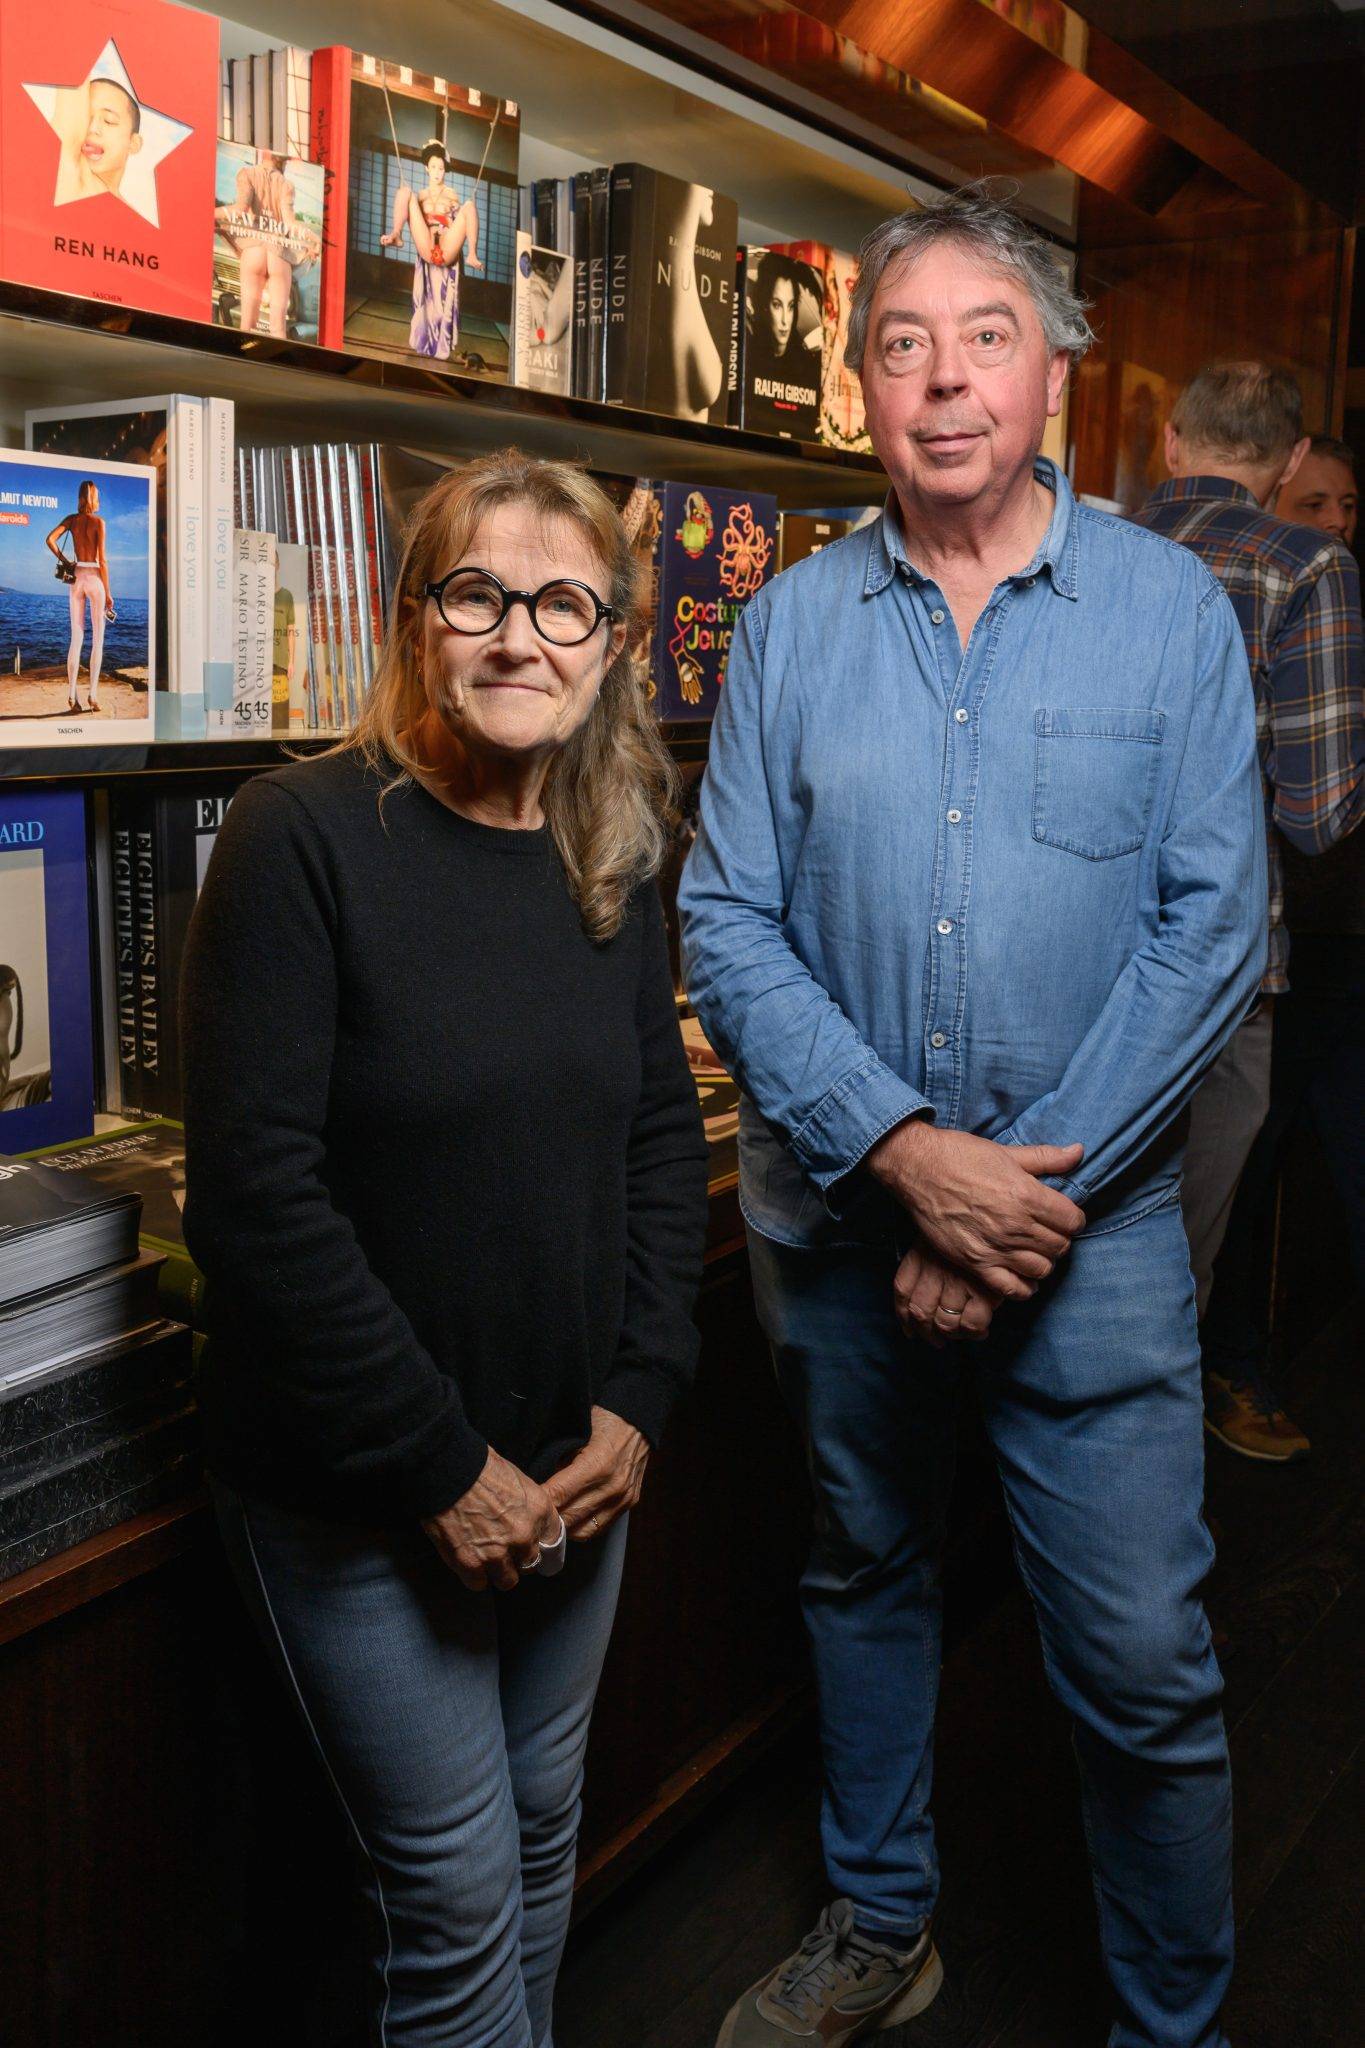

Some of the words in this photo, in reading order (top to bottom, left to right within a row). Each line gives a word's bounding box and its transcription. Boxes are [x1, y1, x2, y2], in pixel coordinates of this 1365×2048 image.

[54, 236, 95, 258] REN
[103, 245, 160, 270] HANG
[92, 291, 122, 303] TASCHEN
[590, 257, 604, 325] NUDE
[611, 254, 626, 323] NUDE
[657, 261, 729, 304] NUDE
[754, 377, 785, 400] RALPH
[785, 384, 817, 407] GIBSON
[0, 492, 21, 505] MUT
[22, 494, 58, 508] NEWTON
[0, 512, 28, 525] aroids
[186, 517, 199, 554] love
[217, 518, 230, 554] love
[239, 538, 250, 561] SIR
[256, 541, 268, 563] SIR
[184, 558, 196, 589] you
[215, 559, 226, 590] you
[313, 551, 324, 590] MARIO
[328, 551, 338, 590] MARIO
[345, 551, 355, 590] MARIO
[239, 573, 249, 624] MARIO
[256, 575, 267, 625] MARIO
[274, 628, 300, 637] mans
[348, 595, 358, 645] TESTINO
[238, 628, 249, 689] TESTINO
[256, 629, 266, 689] TESTINO
[234, 701, 252, 721] 45
[0, 821, 44, 844] ARD
[115, 831, 131, 961] EIGHTIES
[137, 833, 155, 966] EIGHTIES
[119, 971, 136, 1072] BAILEY
[141, 974, 158, 1076] BAILEY
[38, 1152, 79, 1168] UCE
